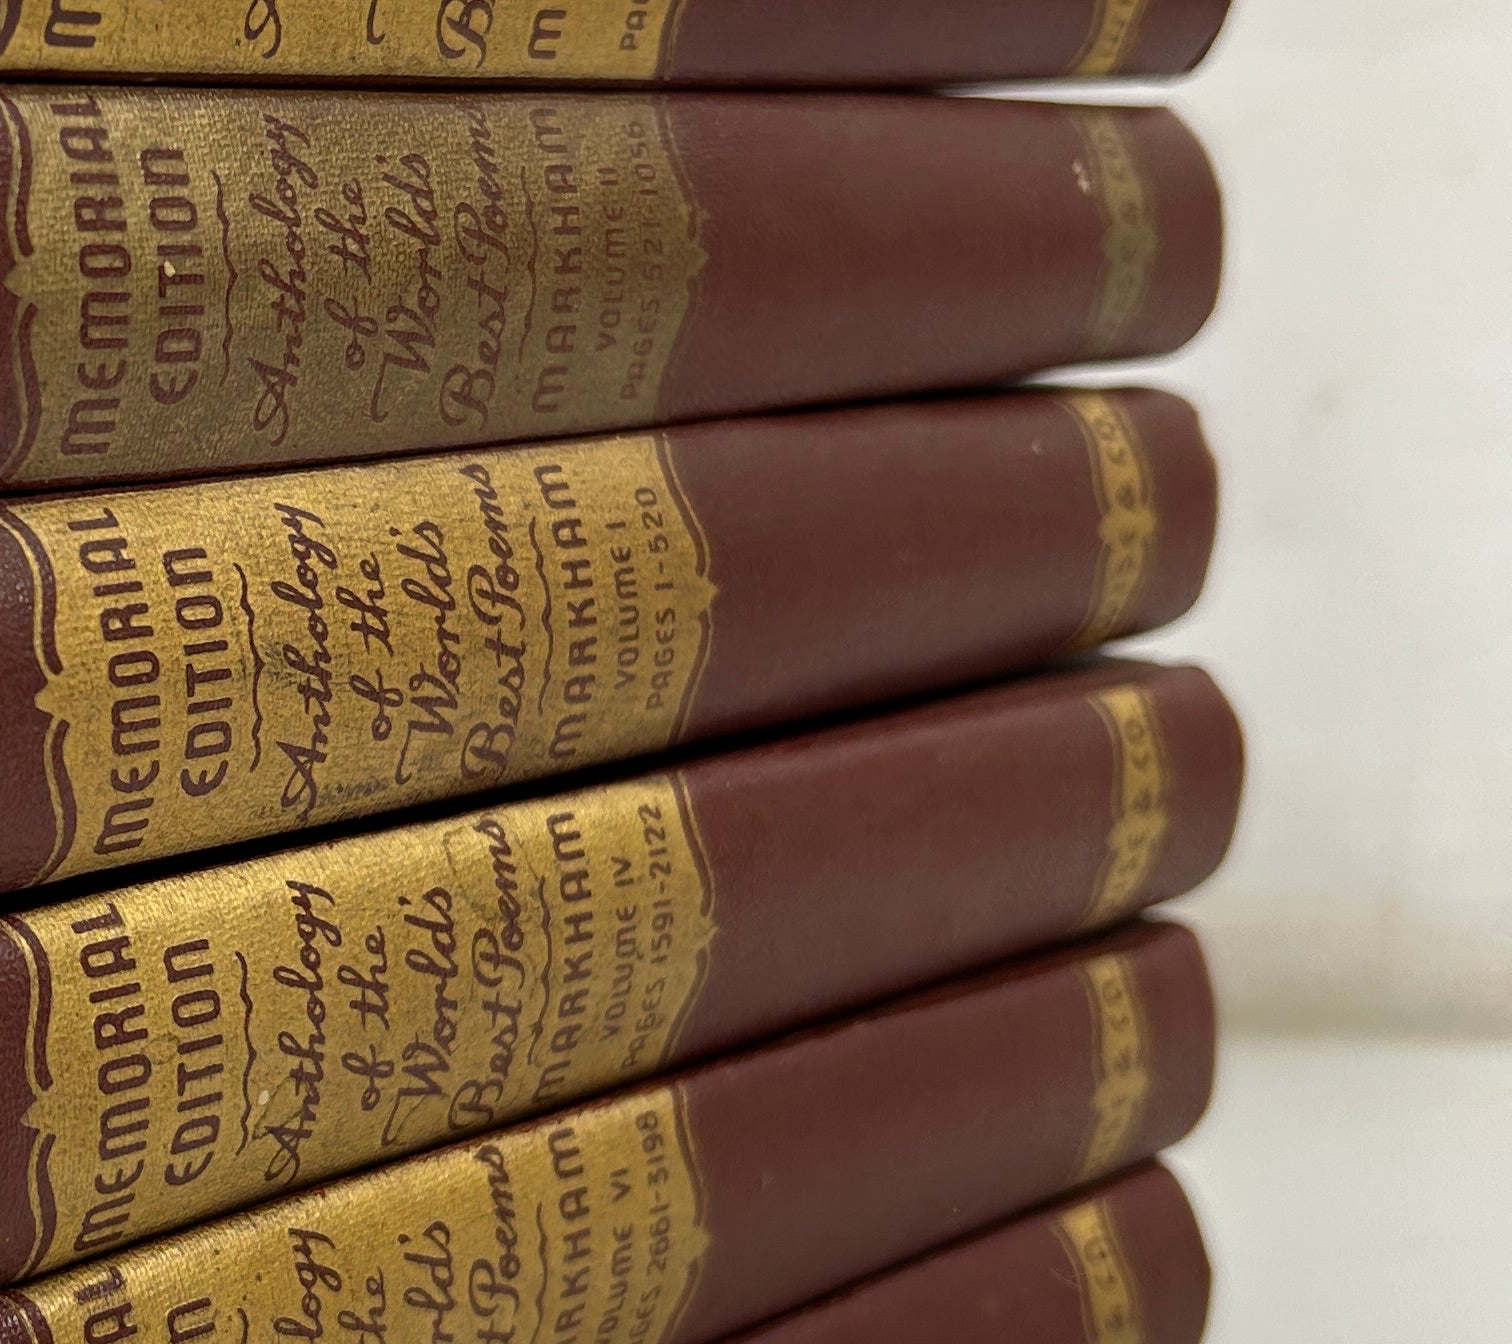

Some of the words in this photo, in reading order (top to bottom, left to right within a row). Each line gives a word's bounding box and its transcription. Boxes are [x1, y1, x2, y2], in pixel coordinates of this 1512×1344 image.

[314, 179, 372, 285] the
[596, 166, 620, 186] II
[48, 94, 132, 454] MEMORIAL
[138, 148, 205, 405] EDITION
[248, 114, 317, 447] Anthology
[324, 298, 378, 370] of
[370, 152, 444, 422] World's
[527, 107, 581, 413] MARKHAM
[595, 205, 626, 352] VOLUME
[440, 271, 508, 428] Best
[619, 298, 661, 400] PAGES
[460, 463, 524, 632] Poems
[605, 519, 627, 531] I
[635, 487, 674, 592] 1-520
[68, 507, 162, 855] MEMORIAL
[163, 546, 233, 797] EDITION
[269, 502, 342, 823] Anthology
[336, 554, 396, 657] the
[393, 521, 463, 785] World's
[530, 464, 598, 757] MARKHAM
[610, 545, 639, 690] VOLUME
[646, 607, 676, 711] PAGES
[349, 671, 402, 741] of
[460, 637, 529, 780] Best
[468, 818, 526, 984] Poems
[610, 856, 635, 888] IV
[639, 804, 674, 964] 1591-2122
[265, 879, 343, 1182] Anthology
[337, 925, 391, 1030] the
[382, 885, 456, 1145] World's
[531, 811, 595, 1105] MARKHAM
[599, 904, 638, 1042] VOLUME
[620, 976, 666, 1072] PAGES
[72, 902, 153, 1252] MEMORIAL
[163, 938, 224, 1187] EDITION
[342, 1051, 395, 1110] of
[449, 990, 522, 1130] Best
[470, 1145, 524, 1318] Poems
[608, 1167, 632, 1204] VI
[636, 1110, 671, 1277] 2661-3198
